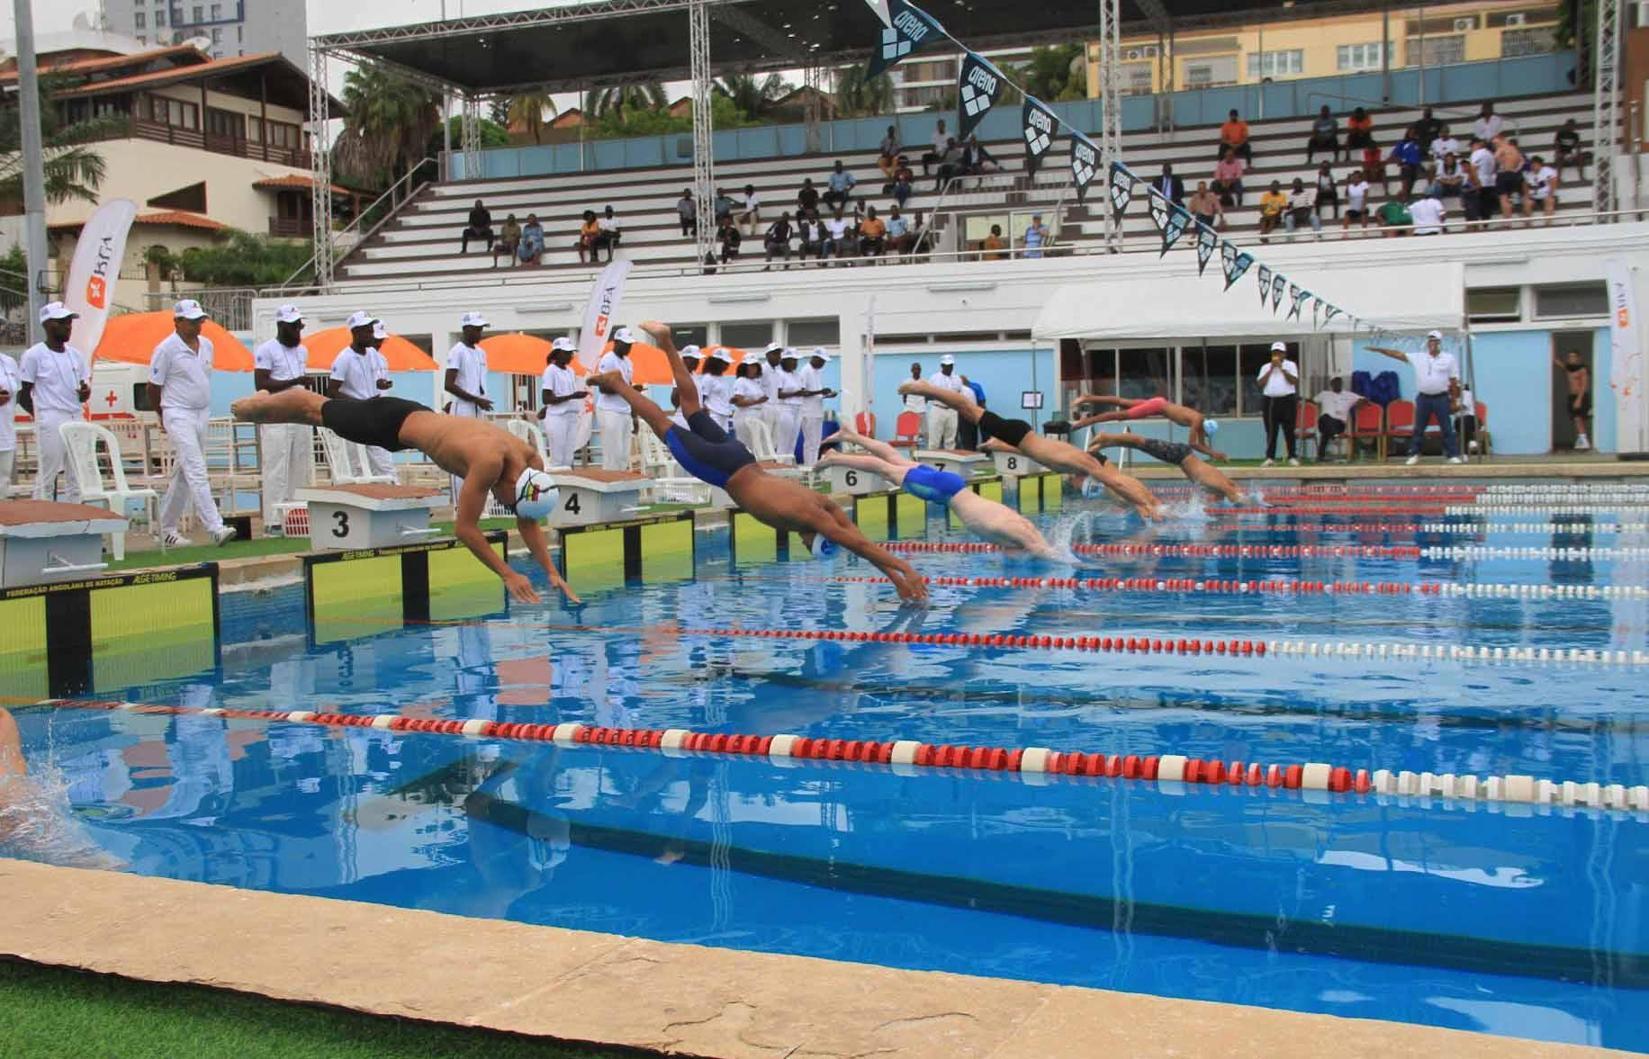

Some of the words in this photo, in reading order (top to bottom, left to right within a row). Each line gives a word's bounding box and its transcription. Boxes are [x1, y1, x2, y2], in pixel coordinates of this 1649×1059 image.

[893, 11, 929, 42] arena
[968, 66, 997, 96] arena
[1007, 457, 1017, 469] 8
[845, 470, 857, 486] 6
[565, 492, 581, 515] 4
[332, 511, 349, 537] 3
